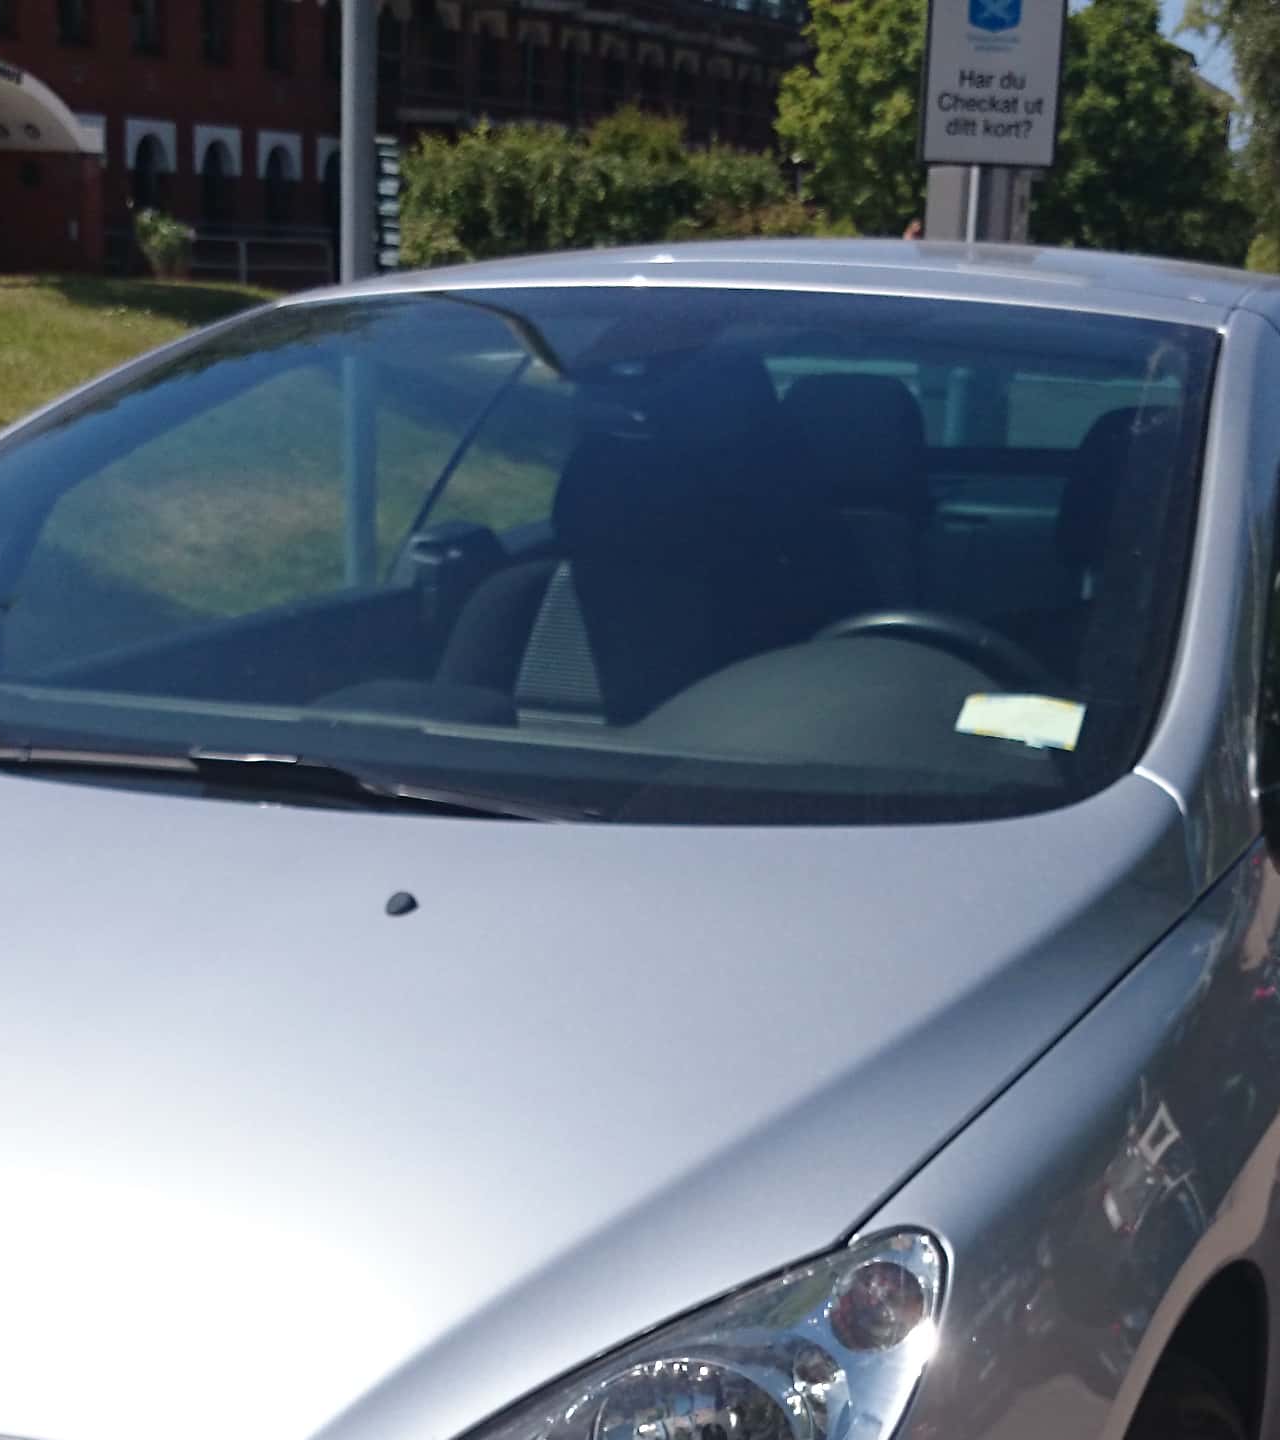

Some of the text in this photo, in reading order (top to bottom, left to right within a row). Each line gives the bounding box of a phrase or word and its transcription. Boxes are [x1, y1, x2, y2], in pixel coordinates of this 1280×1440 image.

[959, 69, 1026, 91] Har du
[937, 92, 1044, 116] Checkat ut
[945, 117, 1033, 139] ditt kort?
